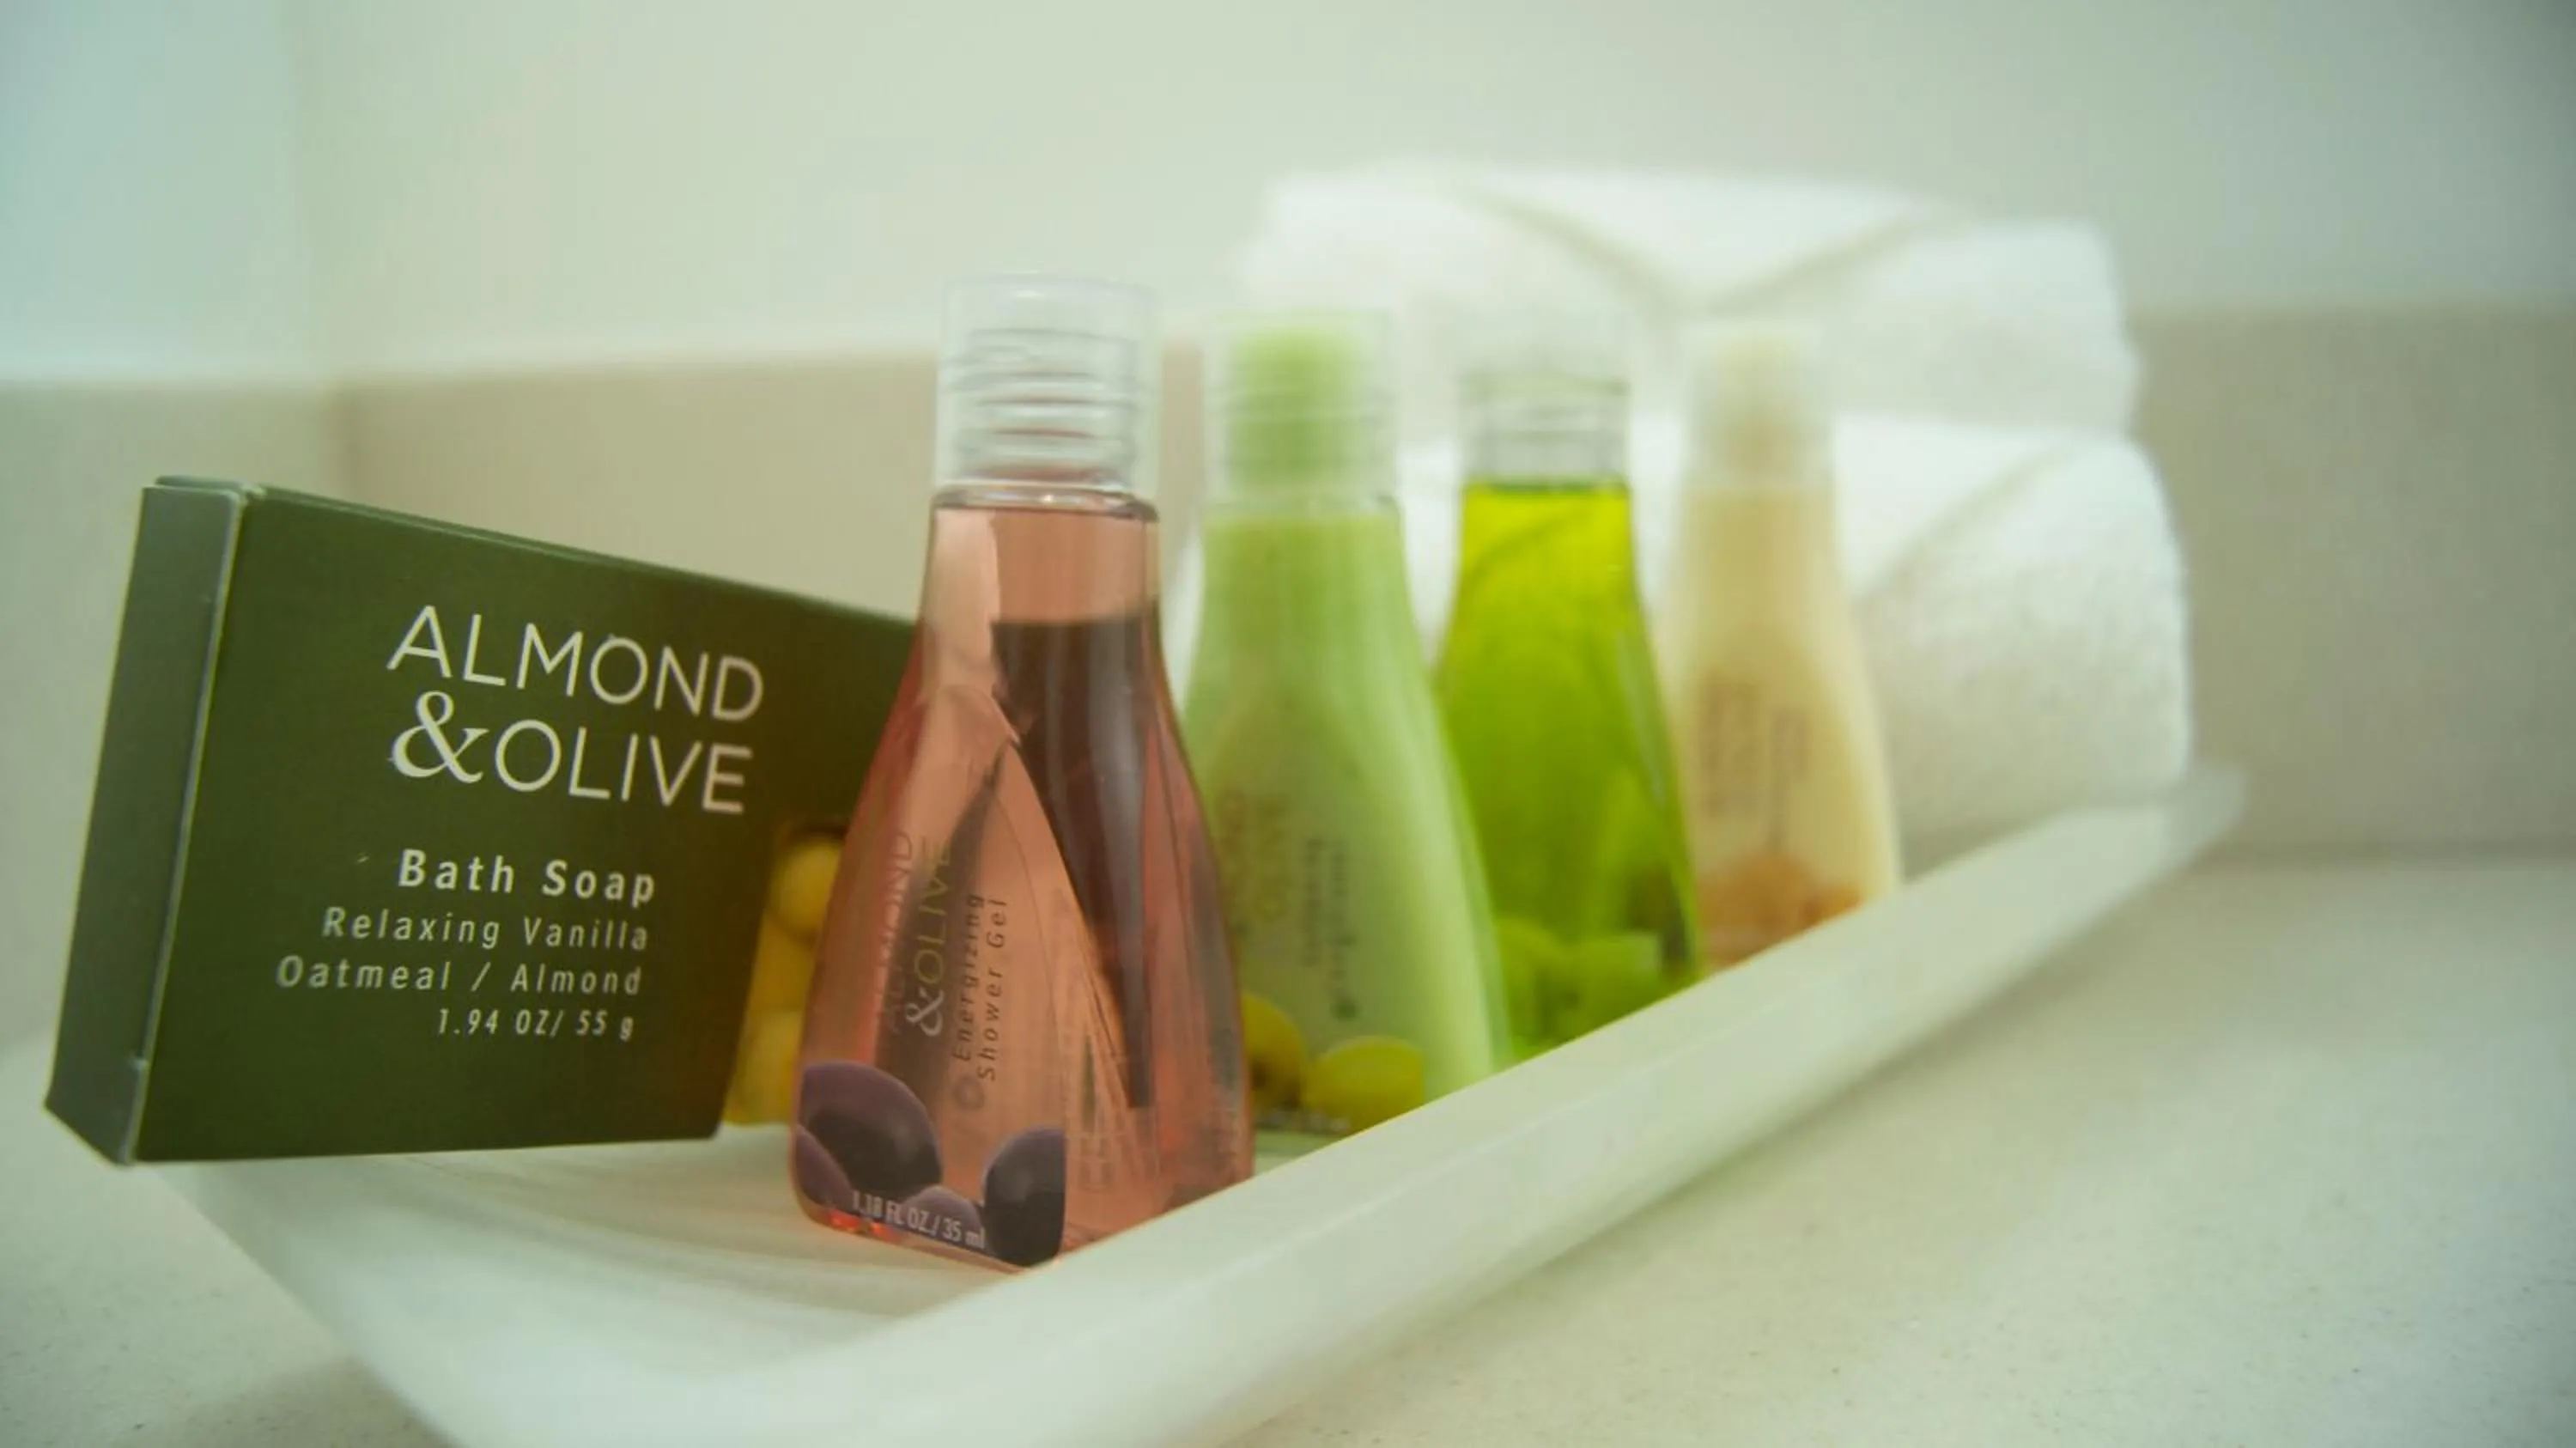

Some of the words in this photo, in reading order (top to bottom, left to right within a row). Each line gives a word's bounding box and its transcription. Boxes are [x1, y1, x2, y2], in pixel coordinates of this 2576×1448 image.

[386, 605, 763, 722] ALMOND
[398, 849, 515, 894] Bath
[542, 859, 656, 909] Soap
[322, 907, 501, 950] Relaxing
[523, 916, 647, 951] Vanilla
[987, 898, 1008, 949] Gel
[276, 955, 451, 995] Oatmeal
[471, 962, 492, 992] /
[511, 964, 642, 996] Almond
[952, 894, 985, 1062] Energizing
[438, 1008, 499, 1036] 1.94
[576, 1010, 609, 1037] 55
[620, 1016, 635, 1042] g
[977, 968, 1003, 1082] Shower
[942, 1218, 963, 1243] 35
[965, 1226, 986, 1250] ml
